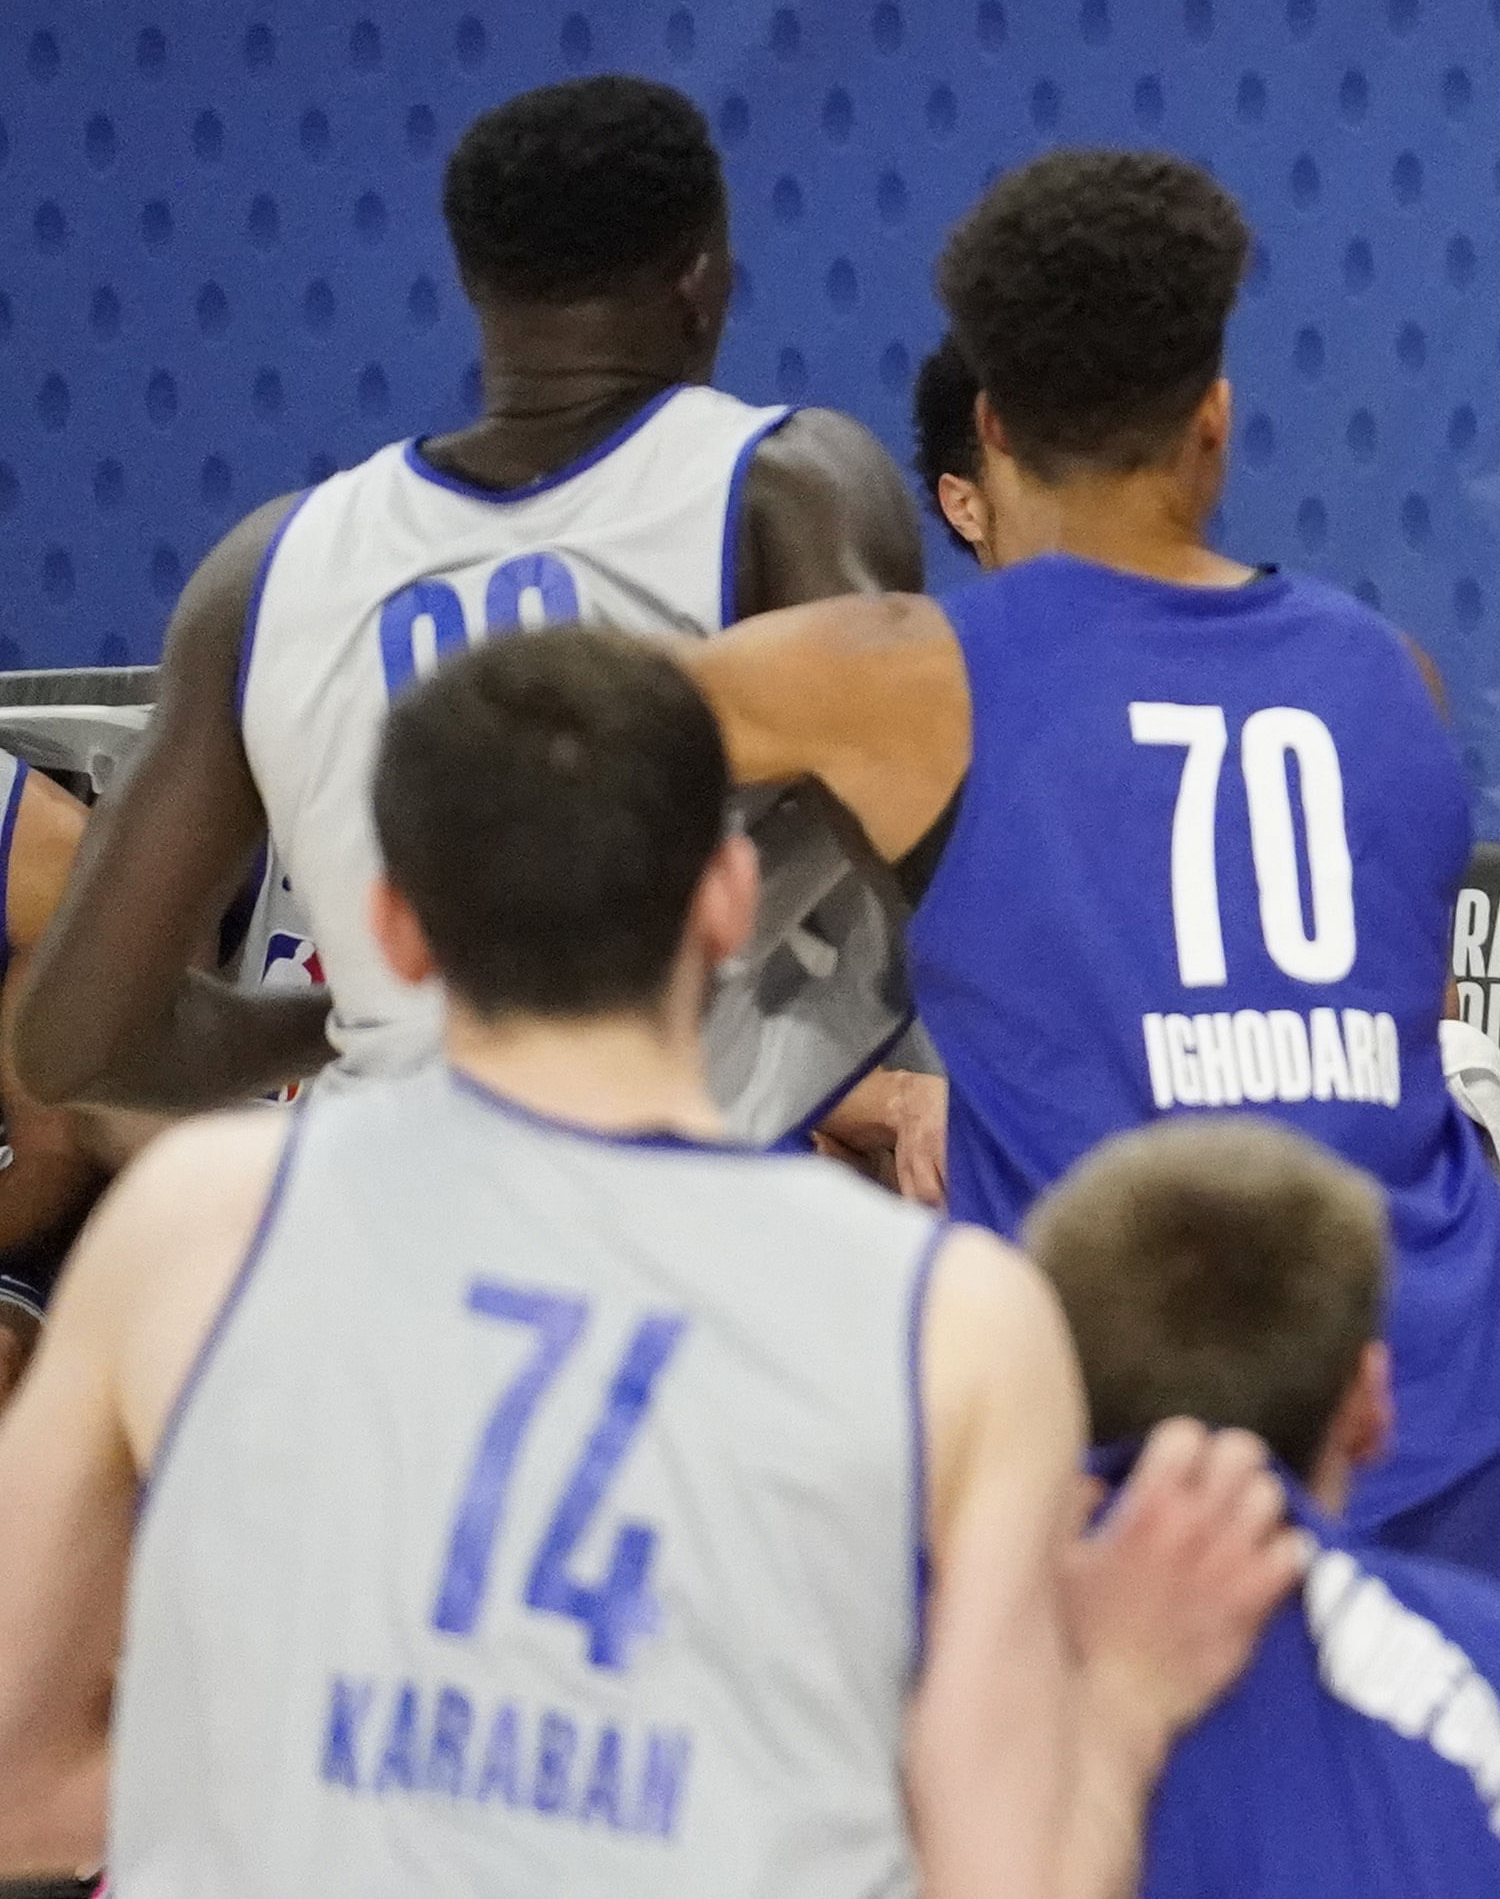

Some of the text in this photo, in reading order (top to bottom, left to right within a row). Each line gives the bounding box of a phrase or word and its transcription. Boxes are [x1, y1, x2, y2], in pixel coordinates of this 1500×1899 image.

[1129, 701, 1357, 987] 70
[431, 1273, 691, 1673] 74
[319, 1673, 692, 1845] KARABAN
